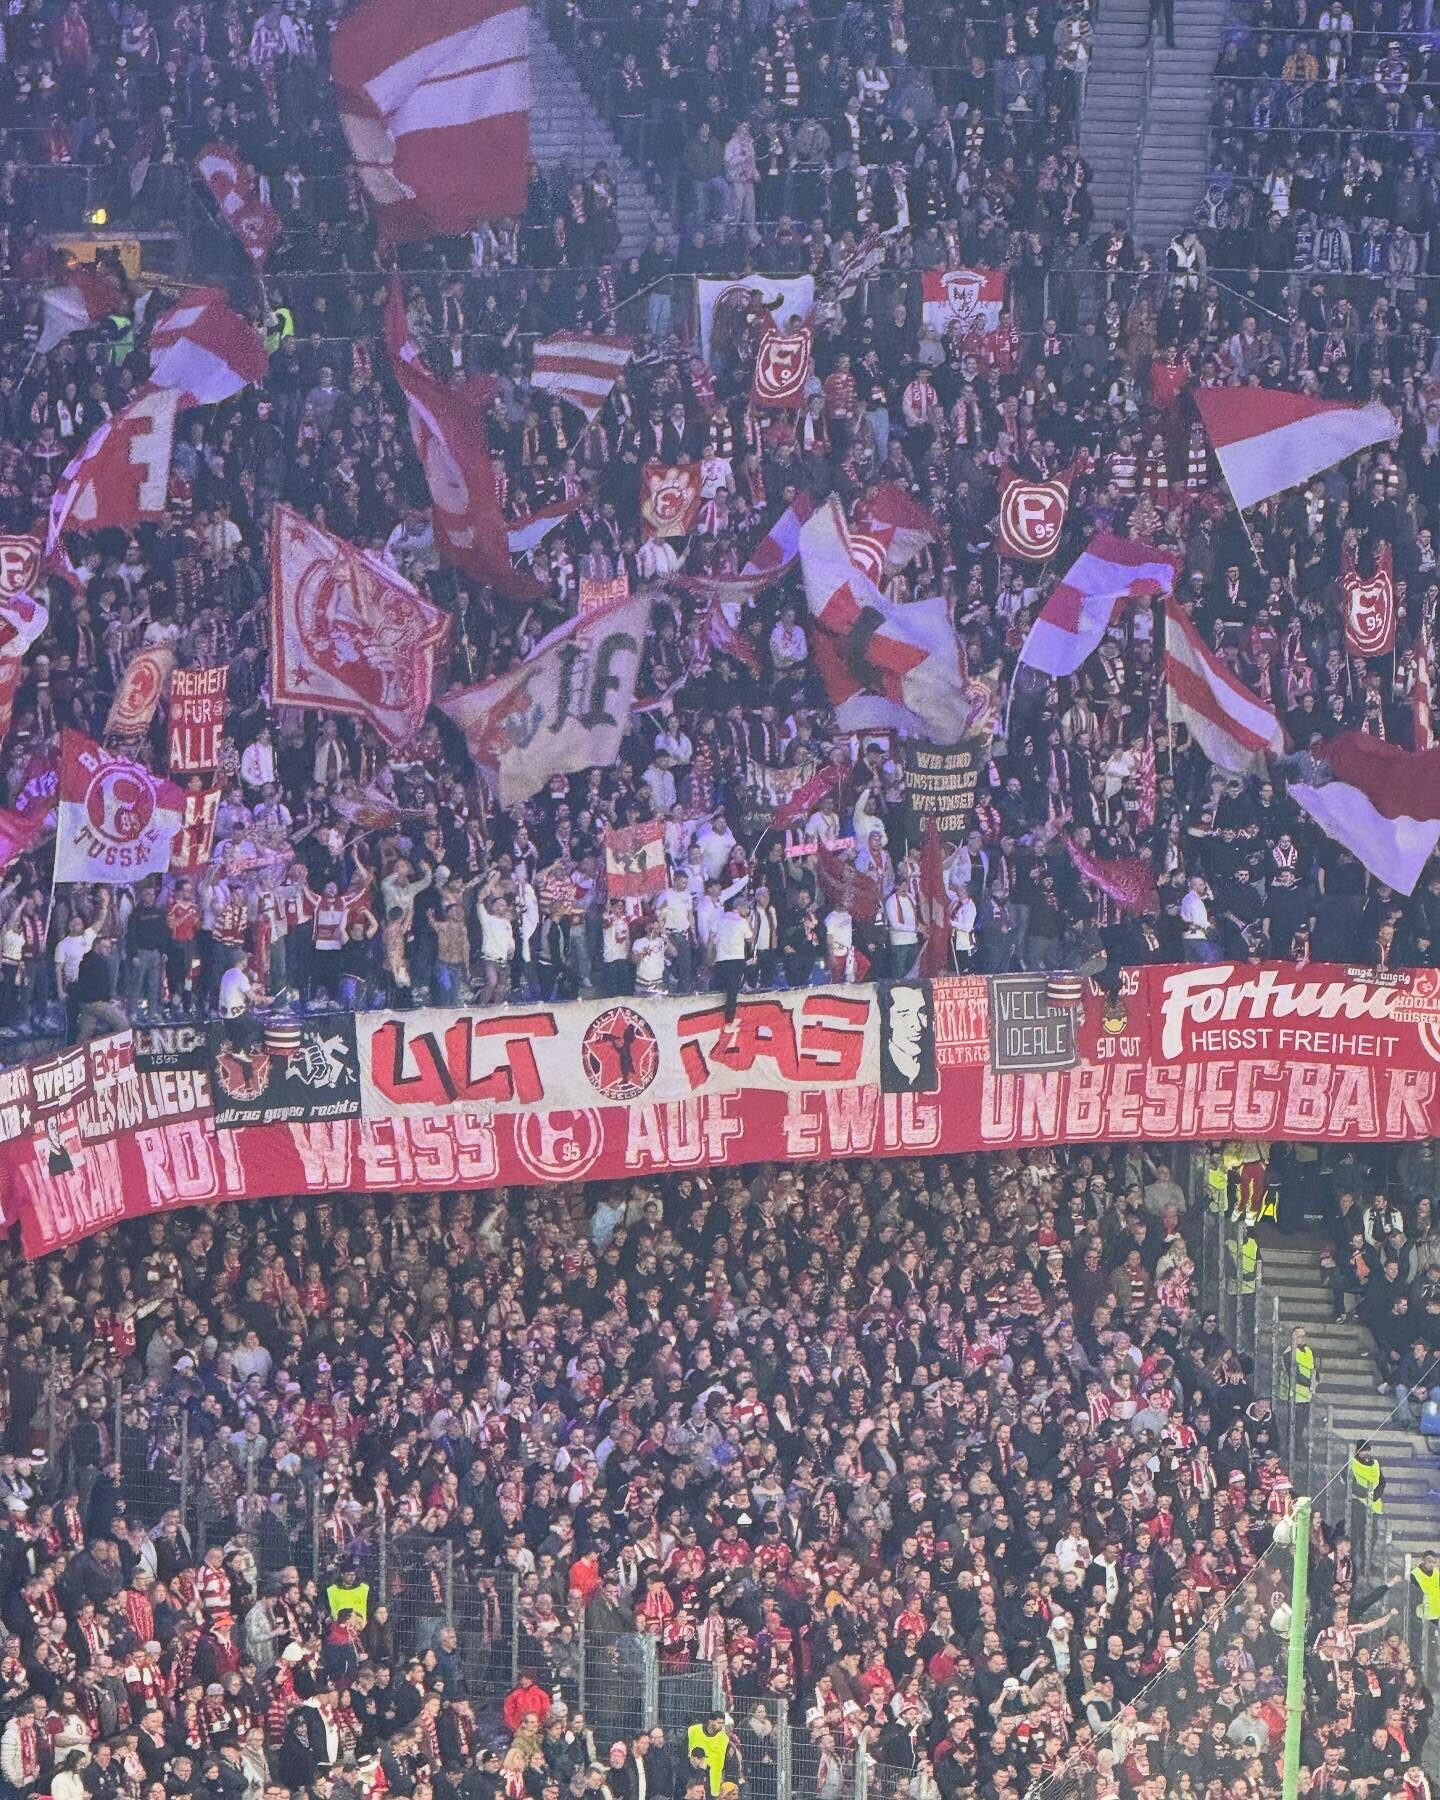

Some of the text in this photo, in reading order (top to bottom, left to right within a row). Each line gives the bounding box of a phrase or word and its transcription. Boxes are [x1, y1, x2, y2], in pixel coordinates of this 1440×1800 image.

[171, 665, 229, 696] FREIHEIT
[933, 998, 989, 1042] KRAFT
[1161, 965, 1400, 1060] Fortuna
[936, 1045, 991, 1065] ULTRAS
[1006, 1024, 1067, 1057] IDEALE
[1191, 1028, 1400, 1058] HEISST FREIHEIT
[140, 1070, 211, 1121] LIEBE
[134, 1117, 245, 1207] ROT
[288, 1112, 500, 1190] WEISS
[623, 1088, 744, 1168] AUF
[783, 1083, 942, 1158] EWIG
[980, 1057, 1437, 1143] UNBESIEGBAR
